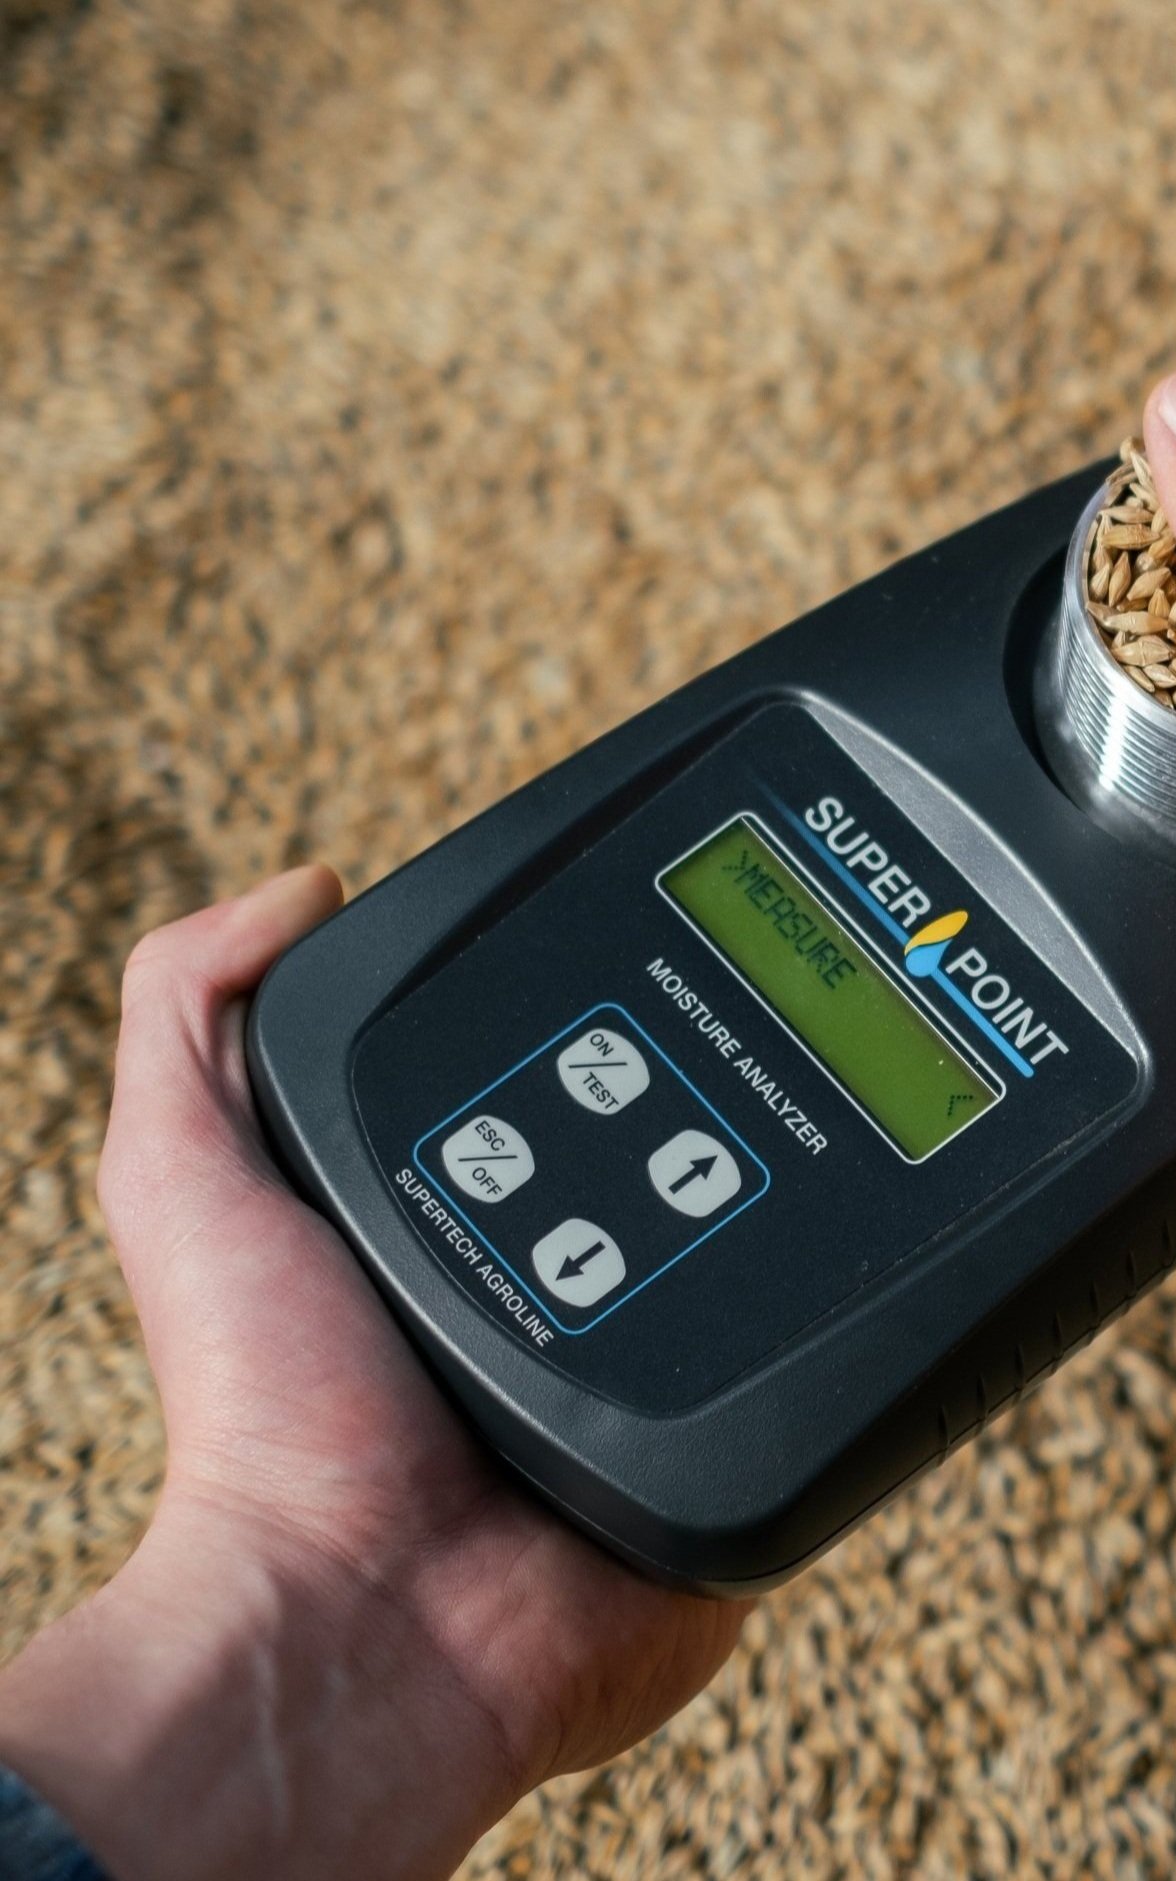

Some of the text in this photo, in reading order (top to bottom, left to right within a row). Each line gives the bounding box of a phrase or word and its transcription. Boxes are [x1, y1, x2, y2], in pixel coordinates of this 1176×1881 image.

[805, 797, 1070, 1066] SUPER POINT
[589, 1033, 614, 1057] ON
[646, 958, 828, 1155] MOISTURE ANALYZER
[582, 1072, 619, 1111] TEST
[475, 1120, 505, 1152] ESC
[472, 1166, 503, 1198] OFF
[395, 1168, 554, 1347] SUPERTECH AGROLINE
